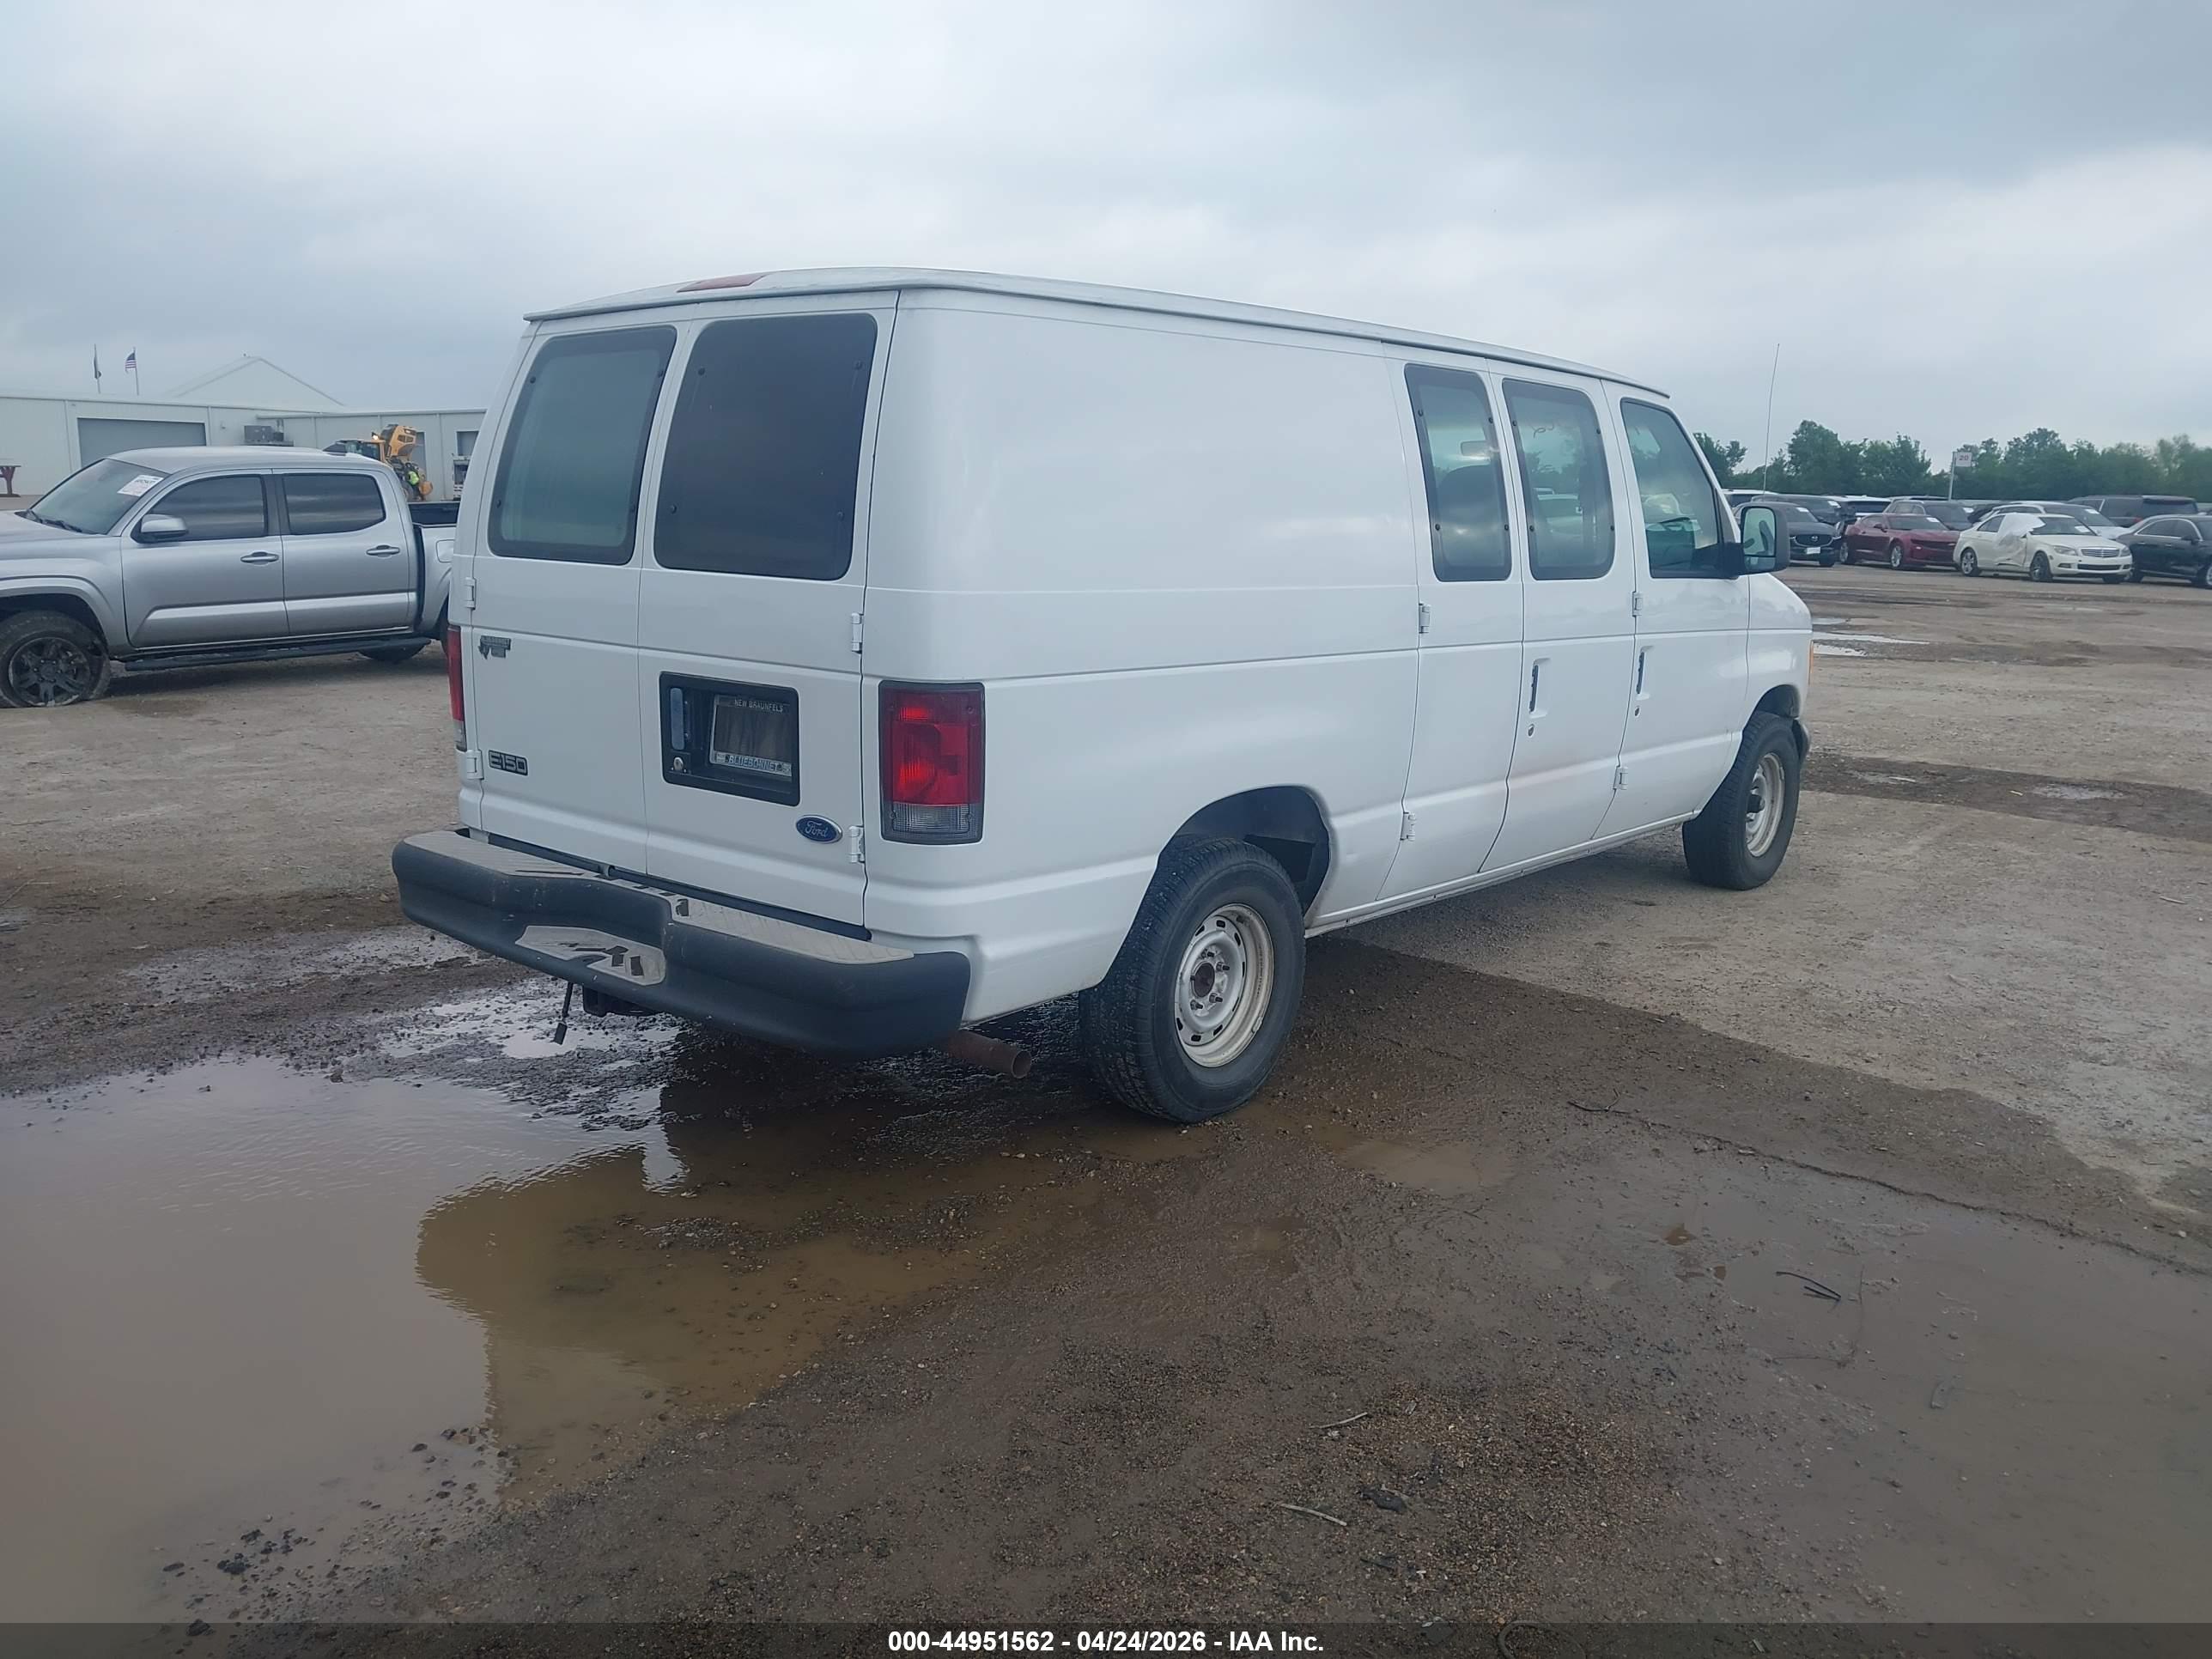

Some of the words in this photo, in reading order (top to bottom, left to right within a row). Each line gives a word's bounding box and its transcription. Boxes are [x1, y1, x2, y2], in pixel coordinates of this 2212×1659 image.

[734, 699, 747, 708] NEW
[749, 702, 784, 713] BRAUNFELS
[728, 755, 778, 772] BLUEBONNET
[805, 820, 829, 838] Ford
